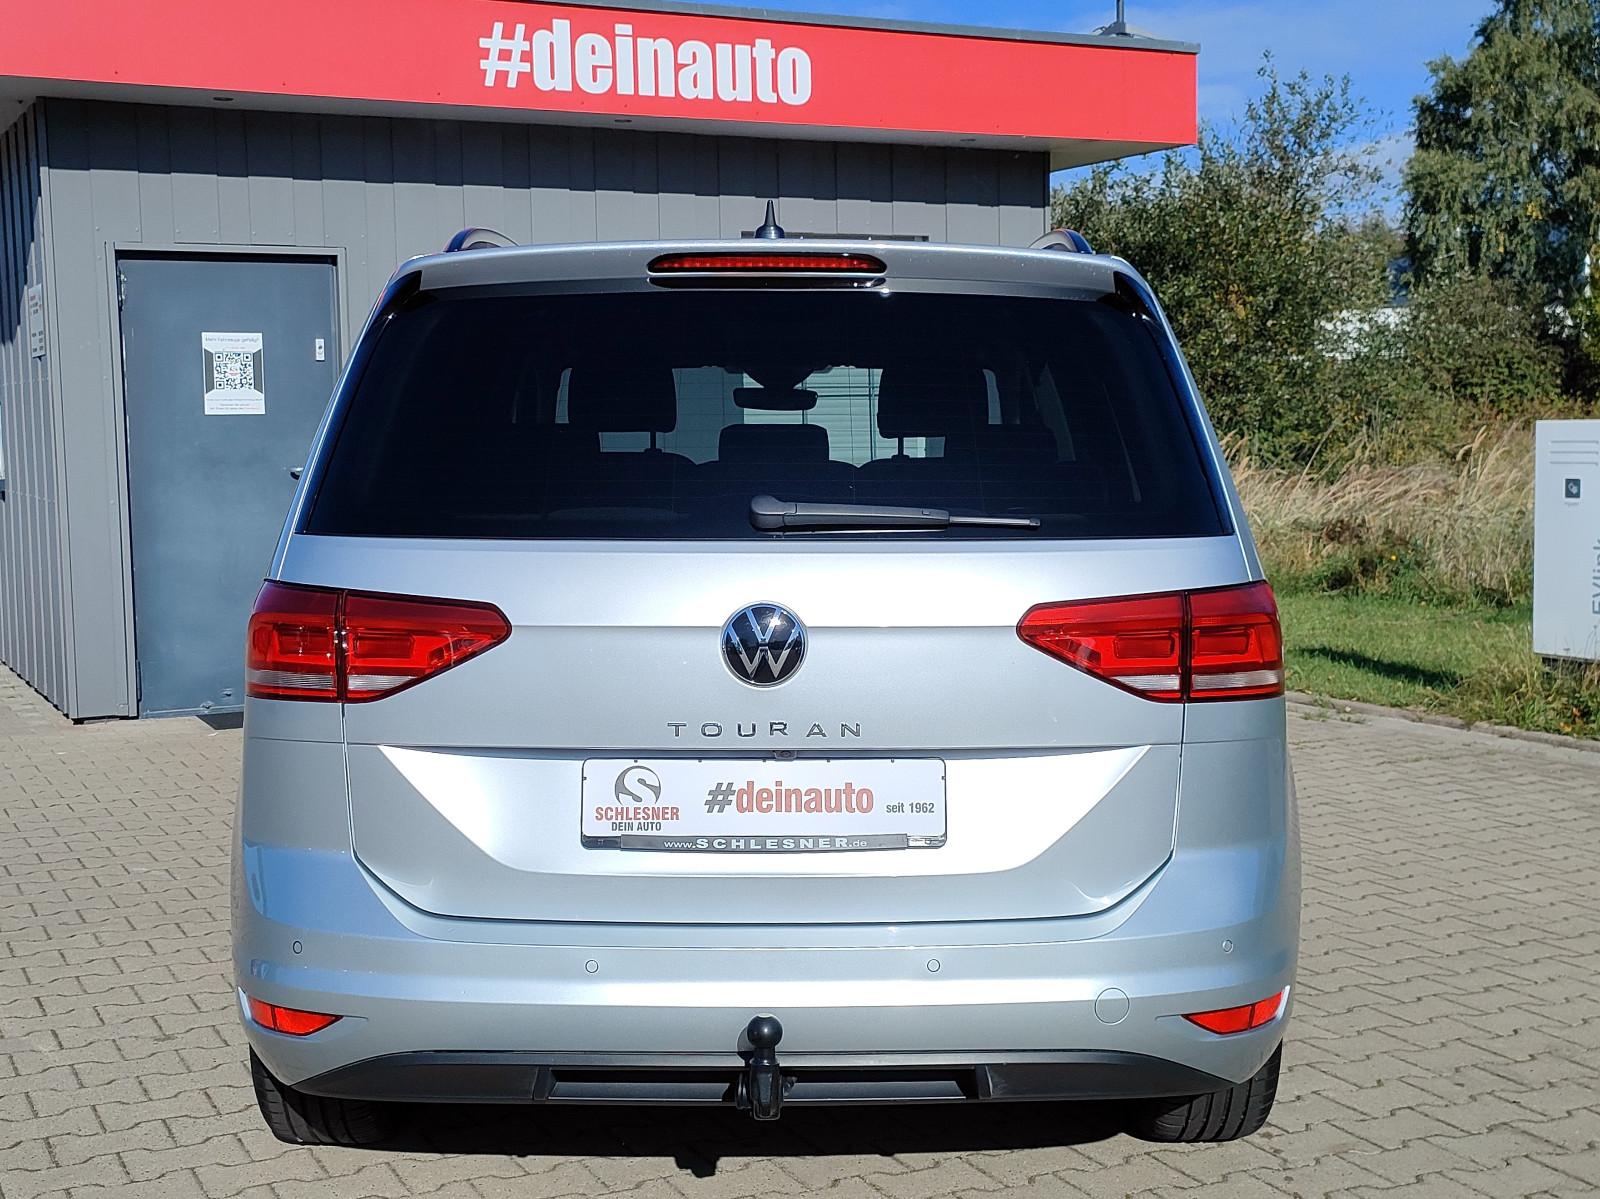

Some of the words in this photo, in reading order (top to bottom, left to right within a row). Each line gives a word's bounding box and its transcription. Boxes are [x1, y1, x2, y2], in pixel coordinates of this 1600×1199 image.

[479, 18, 812, 105] #deinauto
[725, 606, 803, 680] VW
[667, 721, 862, 738] TOURAN
[704, 781, 874, 814] #deinauto
[595, 806, 680, 821] SCHLESNER
[885, 802, 905, 814] seit
[908, 802, 935, 814] 1962
[611, 822, 634, 832] DEIN
[636, 822, 662, 832] AUTO
[663, 837, 868, 850] www.SCHLESNER.de
